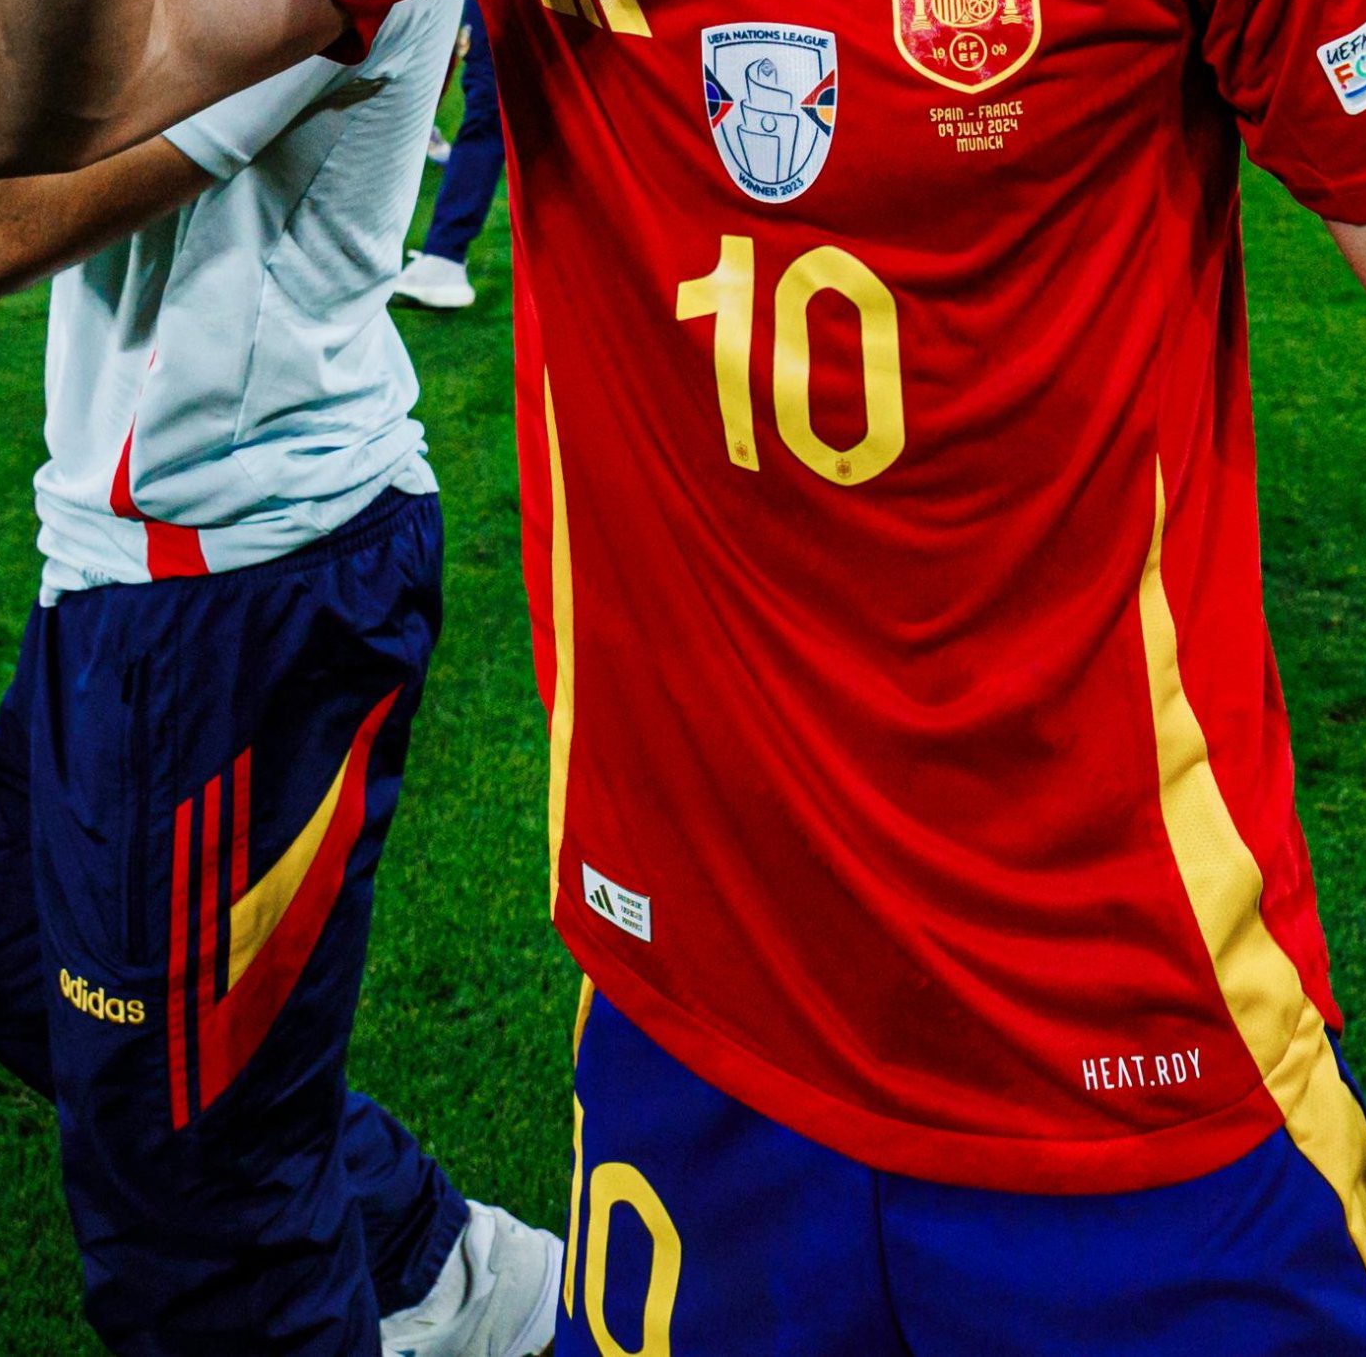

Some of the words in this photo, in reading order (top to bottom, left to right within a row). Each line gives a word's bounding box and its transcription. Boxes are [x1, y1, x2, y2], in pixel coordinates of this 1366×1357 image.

[707, 31, 733, 46] UEFA
[732, 29, 781, 41] NATIONS
[783, 31, 829, 49] LEAGUE
[991, 43, 1008, 56] 09
[932, 46, 946, 60] 19
[929, 107, 964, 122] SPAIN
[978, 100, 1024, 119] FRANCE
[938, 123, 954, 137] 09
[957, 120, 984, 137] JULY
[988, 118, 1019, 134] 2024
[956, 135, 1004, 152] MUNICH
[738, 172, 779, 197] WINNER
[780, 177, 805, 196] 2023
[676, 234, 905, 486] 10
[59, 968, 146, 1024] adidas
[1081, 1047, 1201, 1091] HEAT.RDY
